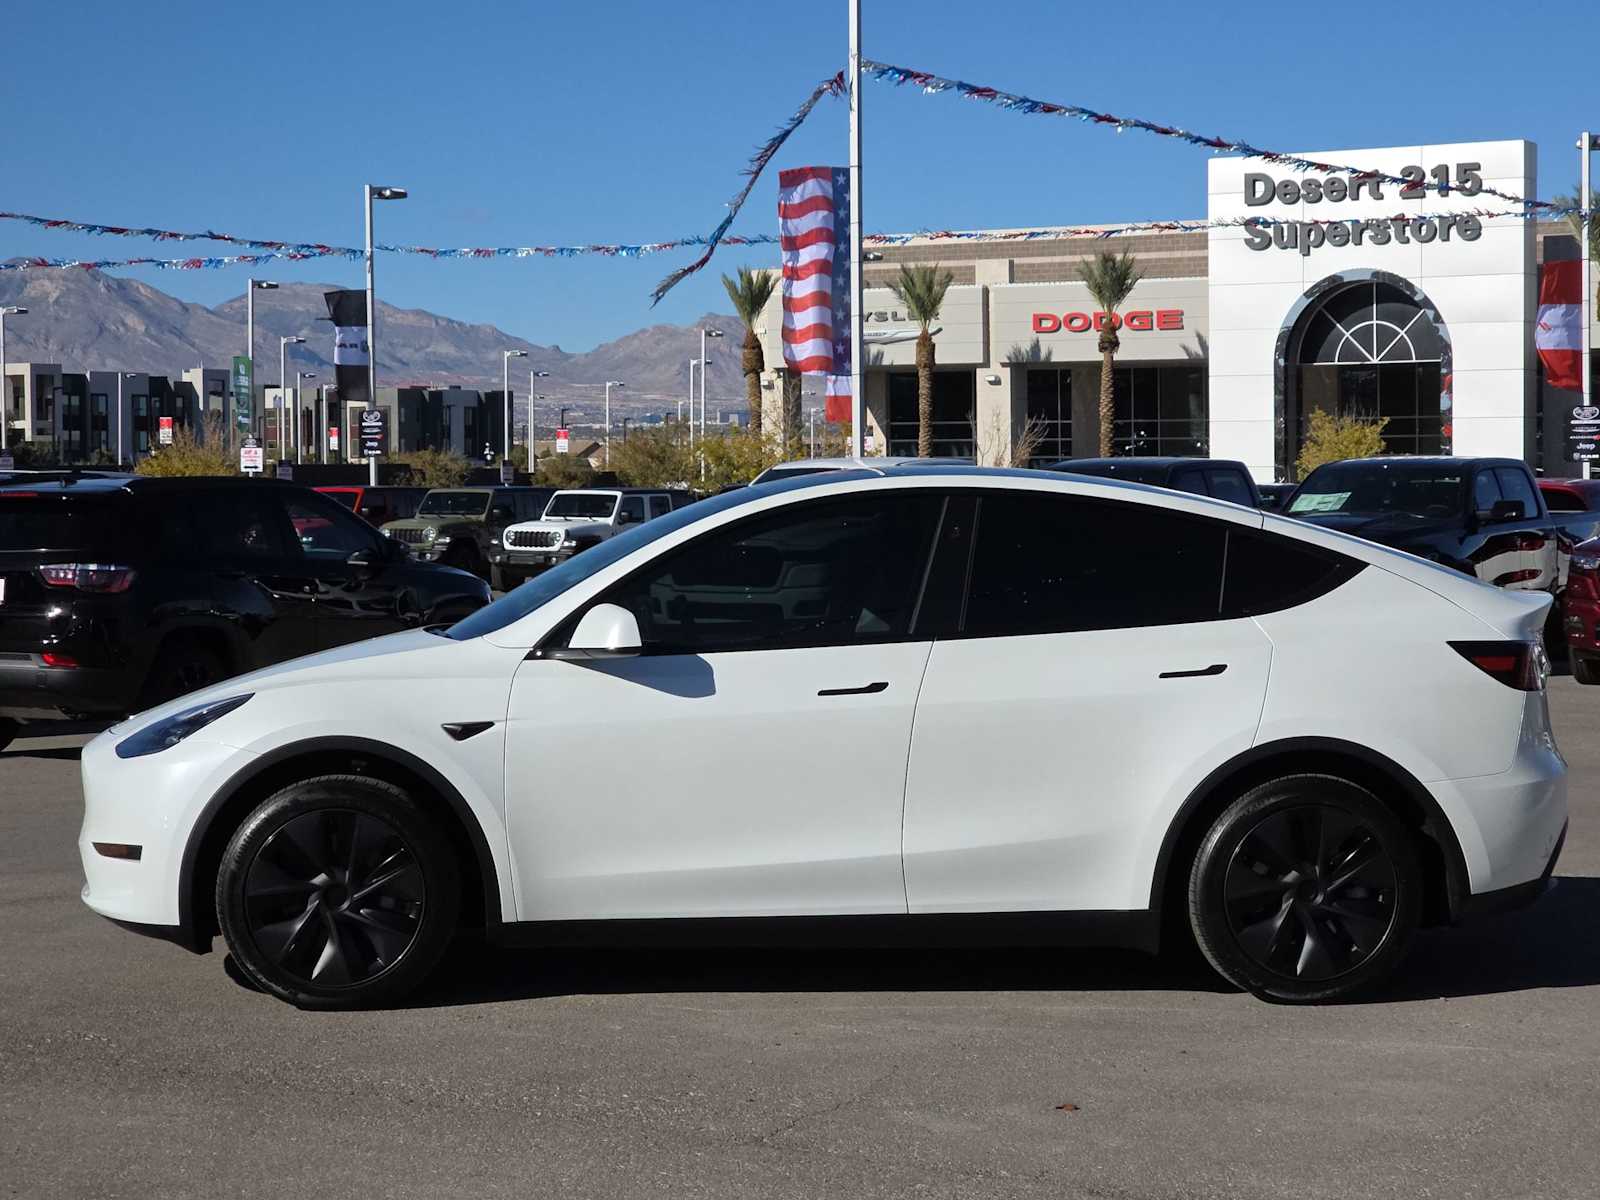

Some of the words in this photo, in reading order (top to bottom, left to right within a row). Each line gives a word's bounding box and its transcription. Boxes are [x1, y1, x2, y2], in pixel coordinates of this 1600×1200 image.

[1244, 169, 1384, 206] Desert
[1400, 162, 1482, 199] 215
[1244, 213, 1482, 256] Superstore
[1032, 309, 1184, 332] DODGE
